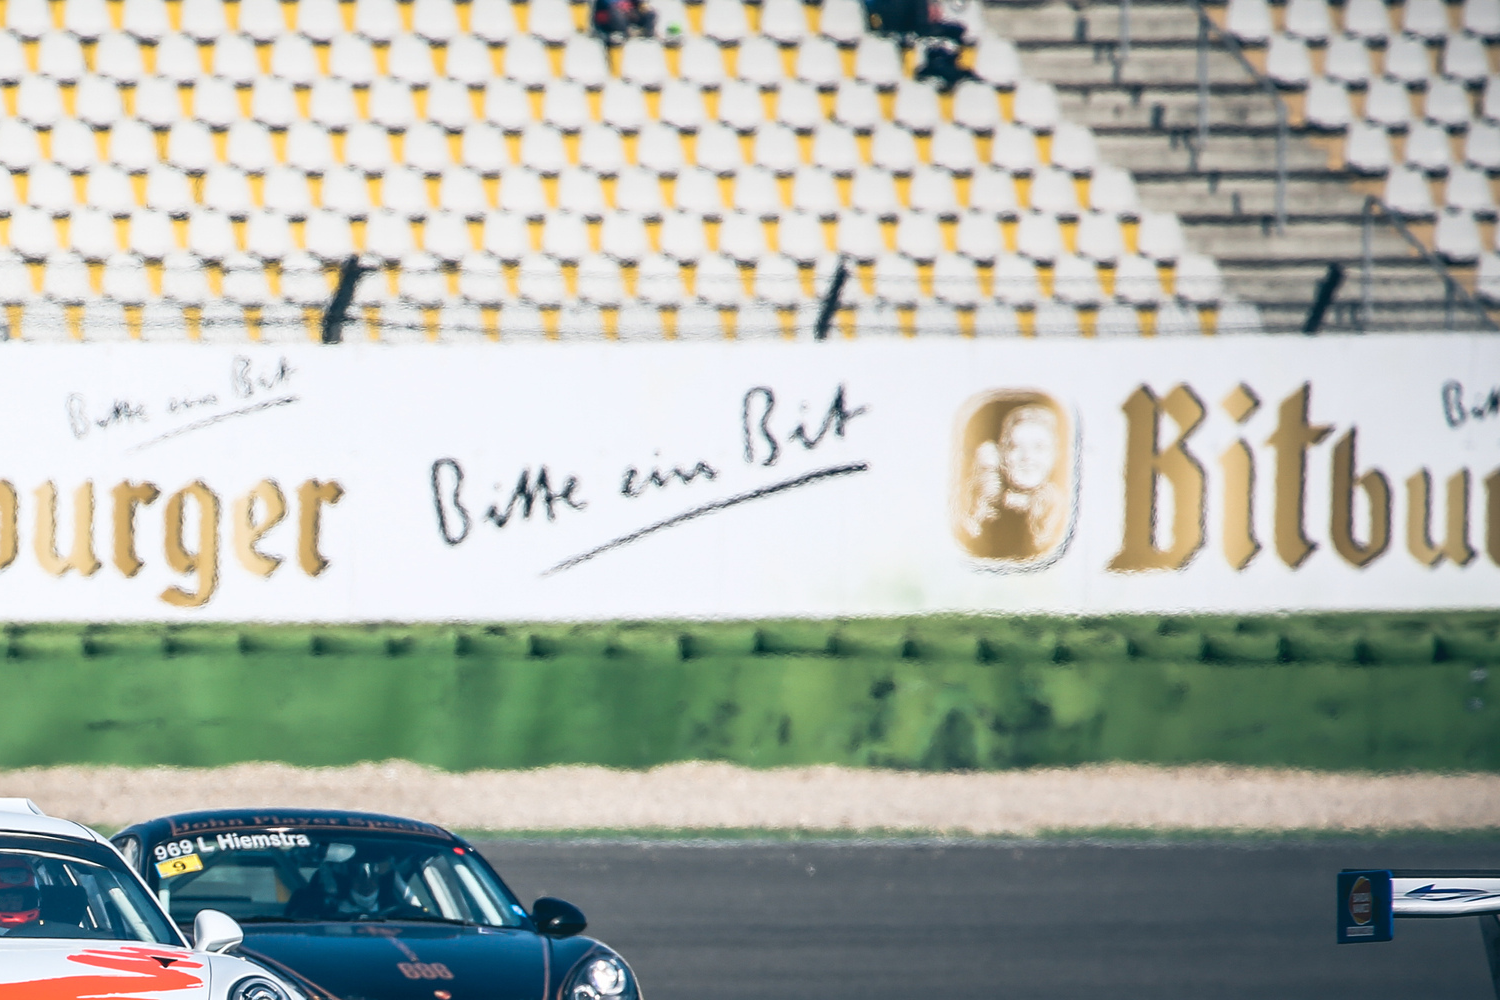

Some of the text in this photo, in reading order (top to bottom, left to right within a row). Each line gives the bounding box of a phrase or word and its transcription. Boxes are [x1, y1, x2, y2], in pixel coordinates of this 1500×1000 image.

[431, 382, 871, 547] Bitte ein Bit
[1102, 378, 1500, 574] Bitbu
[154, 839, 194, 861] 969
[197, 837, 215, 853] L
[216, 832, 311, 851] Hiemstra
[172, 860, 187, 872] 9
